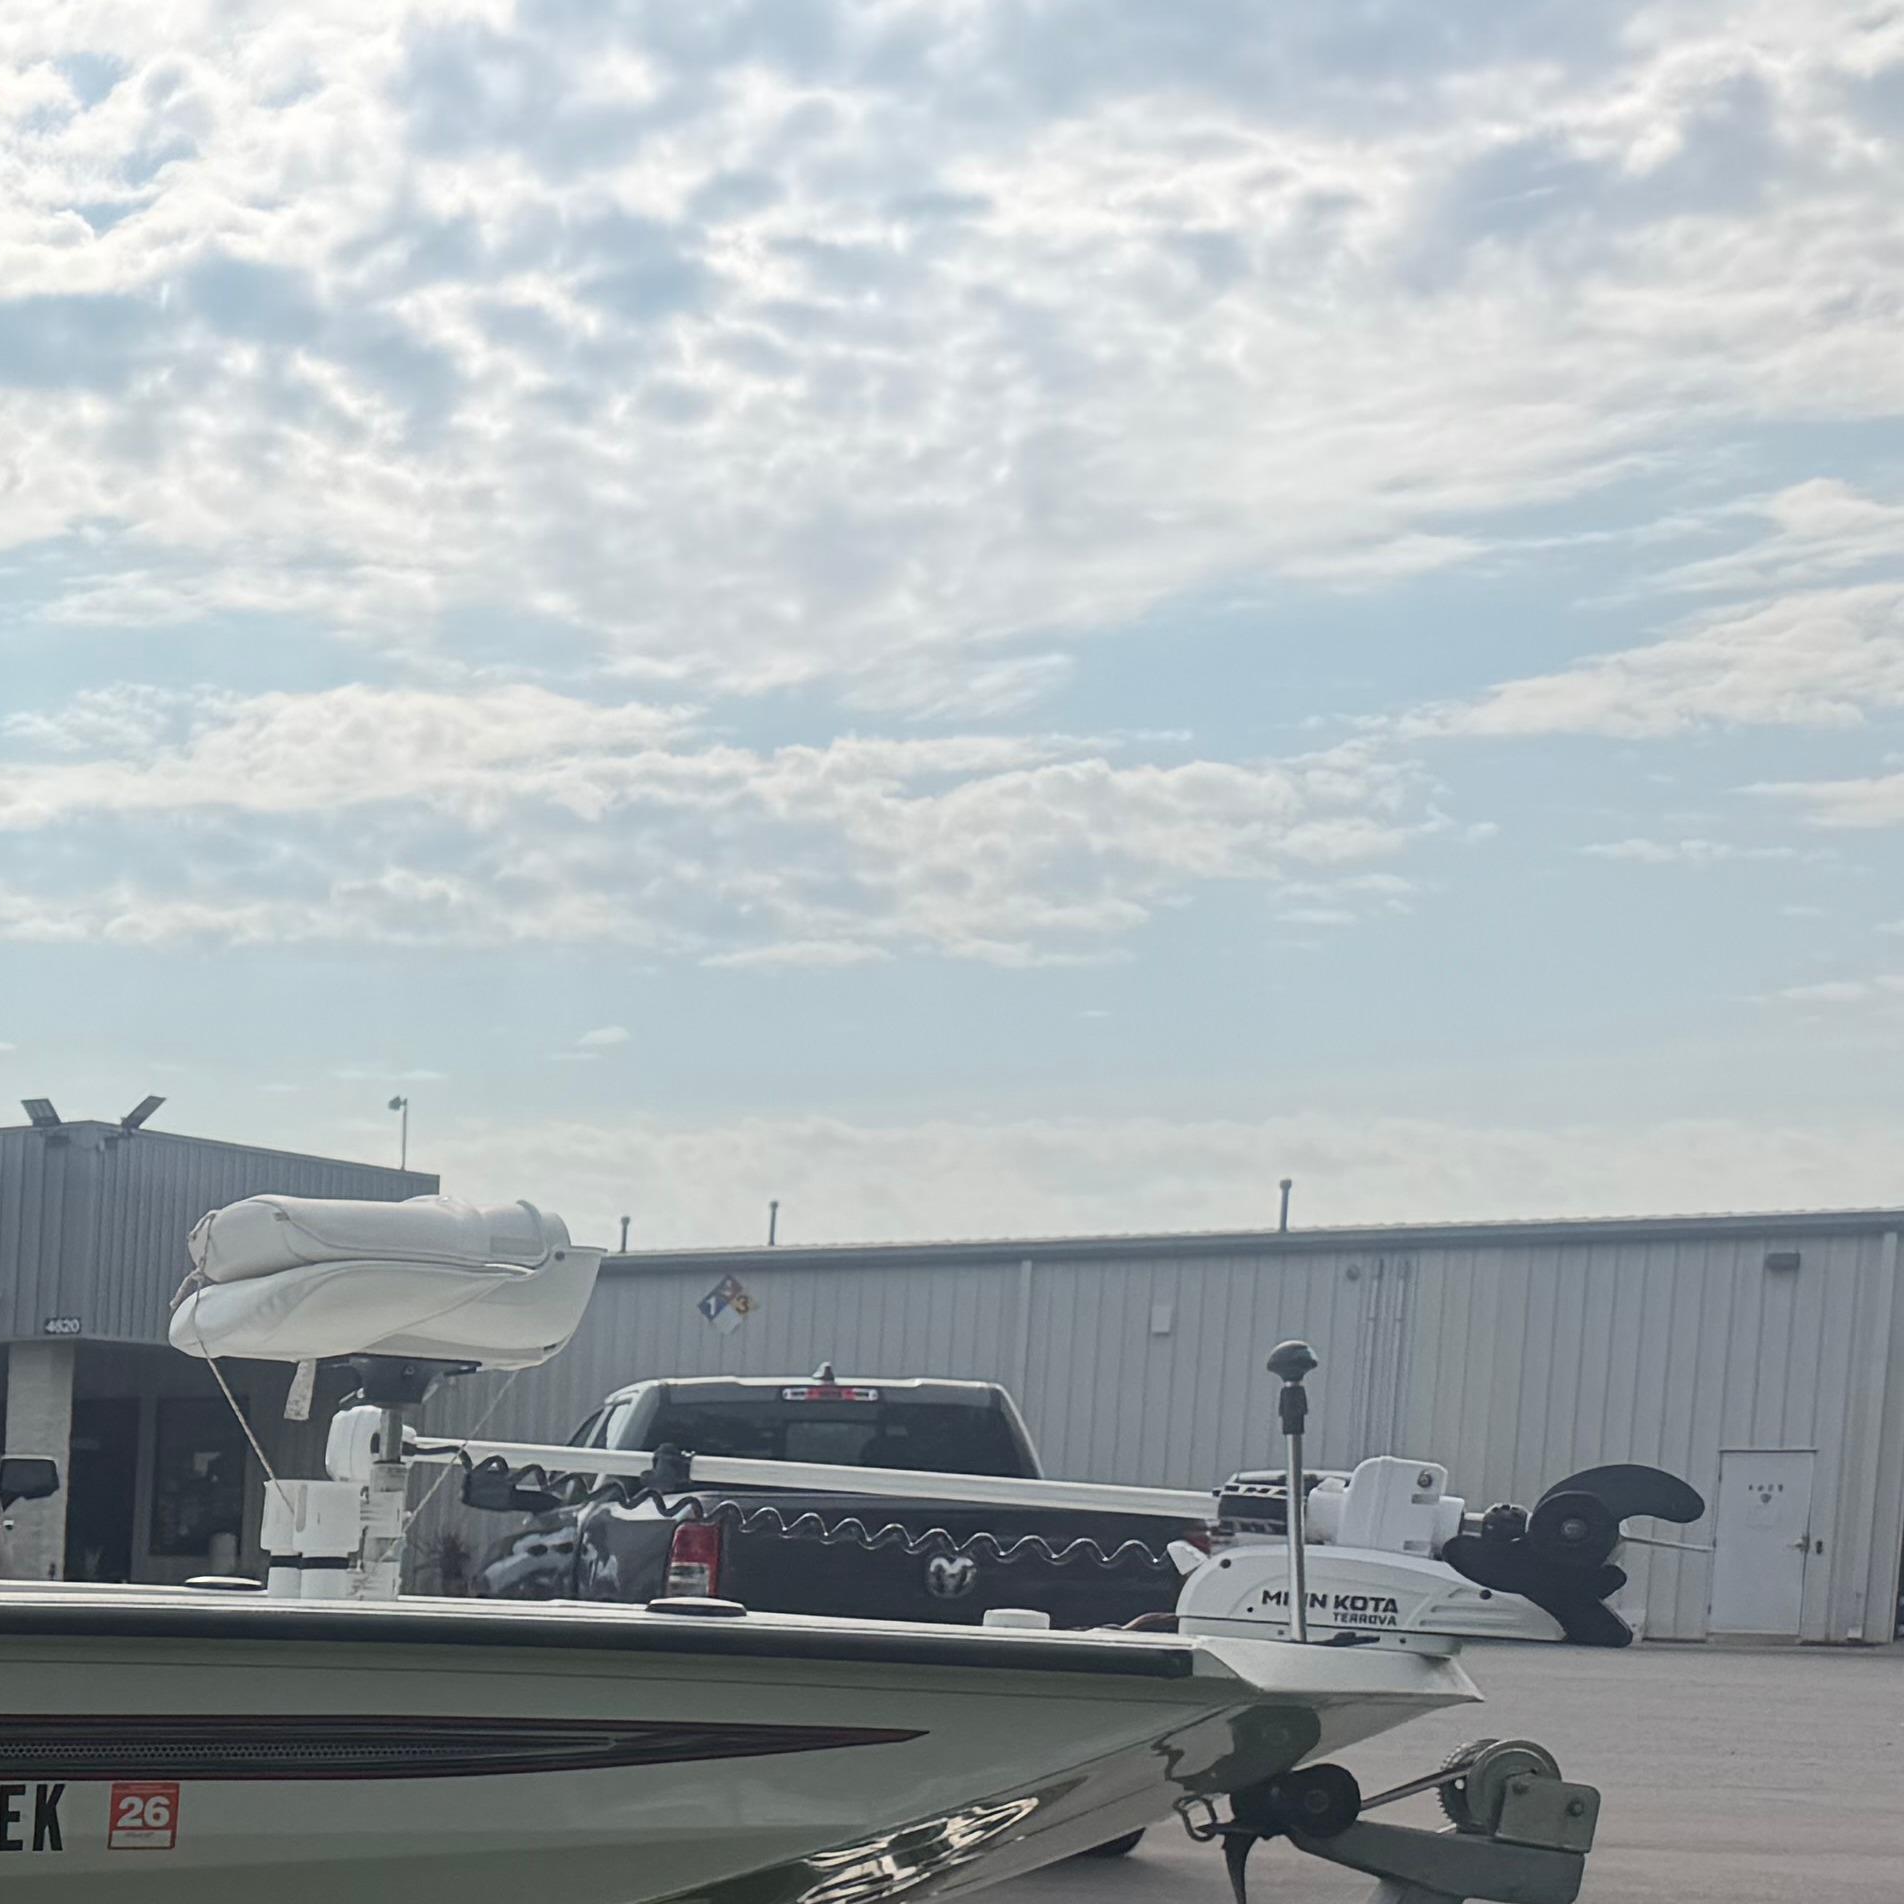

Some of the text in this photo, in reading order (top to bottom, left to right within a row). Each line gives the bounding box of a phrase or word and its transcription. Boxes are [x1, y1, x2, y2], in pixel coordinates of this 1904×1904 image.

[1261, 1590, 1399, 1614] MIN KOTA
[1333, 1612, 1398, 1627] TERROVA
[116, 1795, 171, 1828] 26
